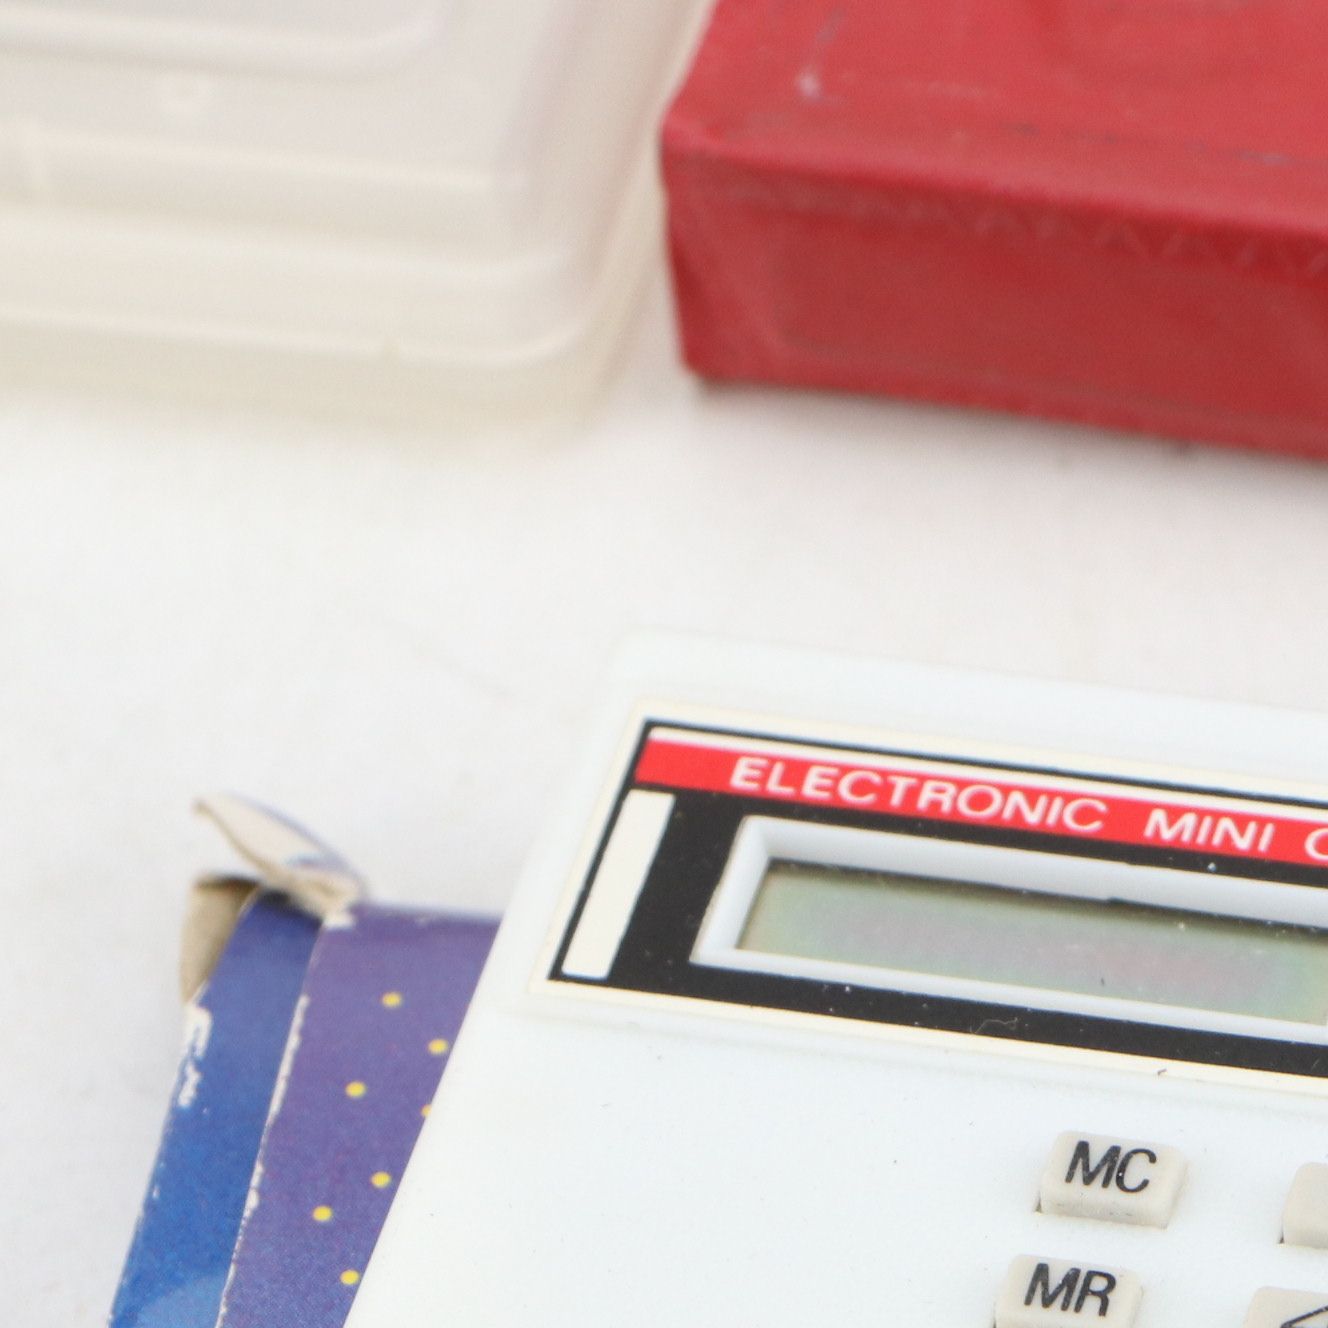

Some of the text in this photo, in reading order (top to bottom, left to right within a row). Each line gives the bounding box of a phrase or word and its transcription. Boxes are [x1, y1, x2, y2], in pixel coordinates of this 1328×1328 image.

[729, 756, 1108, 835] ELECTRONIC
[1144, 808, 1275, 854] MINI
[1065, 1140, 1158, 1194] MC
[1023, 1263, 1117, 1318] MR
